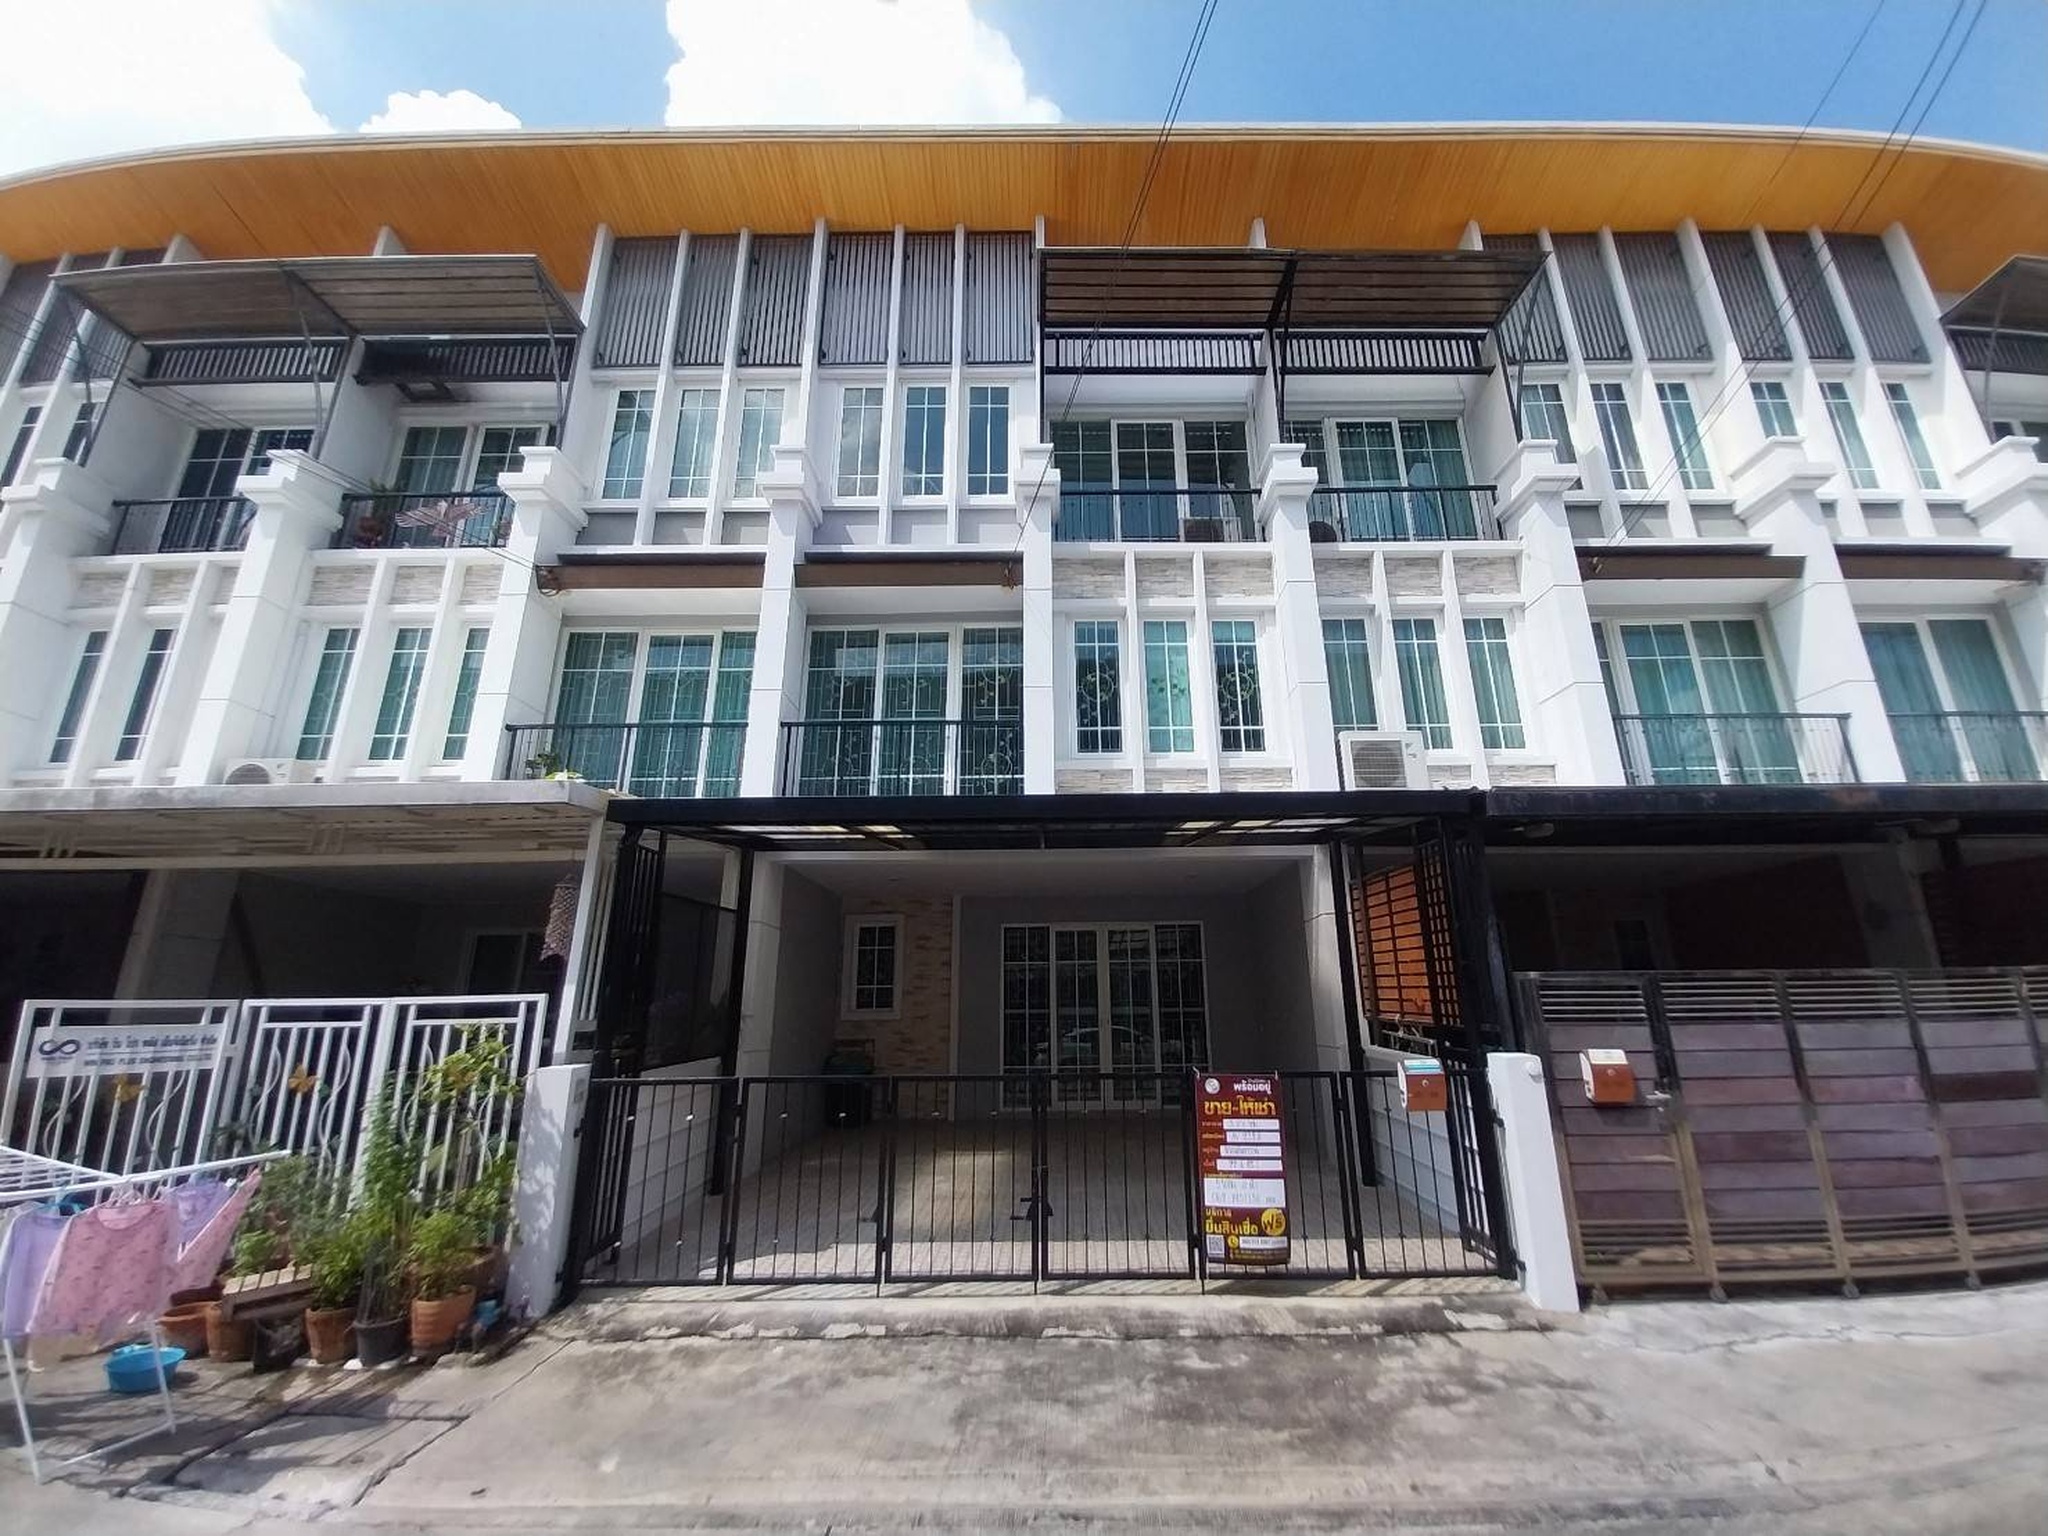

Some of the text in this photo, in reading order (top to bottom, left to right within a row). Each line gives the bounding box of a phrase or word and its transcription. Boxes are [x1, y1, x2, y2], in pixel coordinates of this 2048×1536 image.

[1233, 1079, 1271, 1094] พร้อมอยู่
[1205, 1208, 1232, 1217] บริการ
[1263, 1211, 1282, 1231] ฟรี
[1205, 1216, 1259, 1235] ยื่นสินเชื่อ
